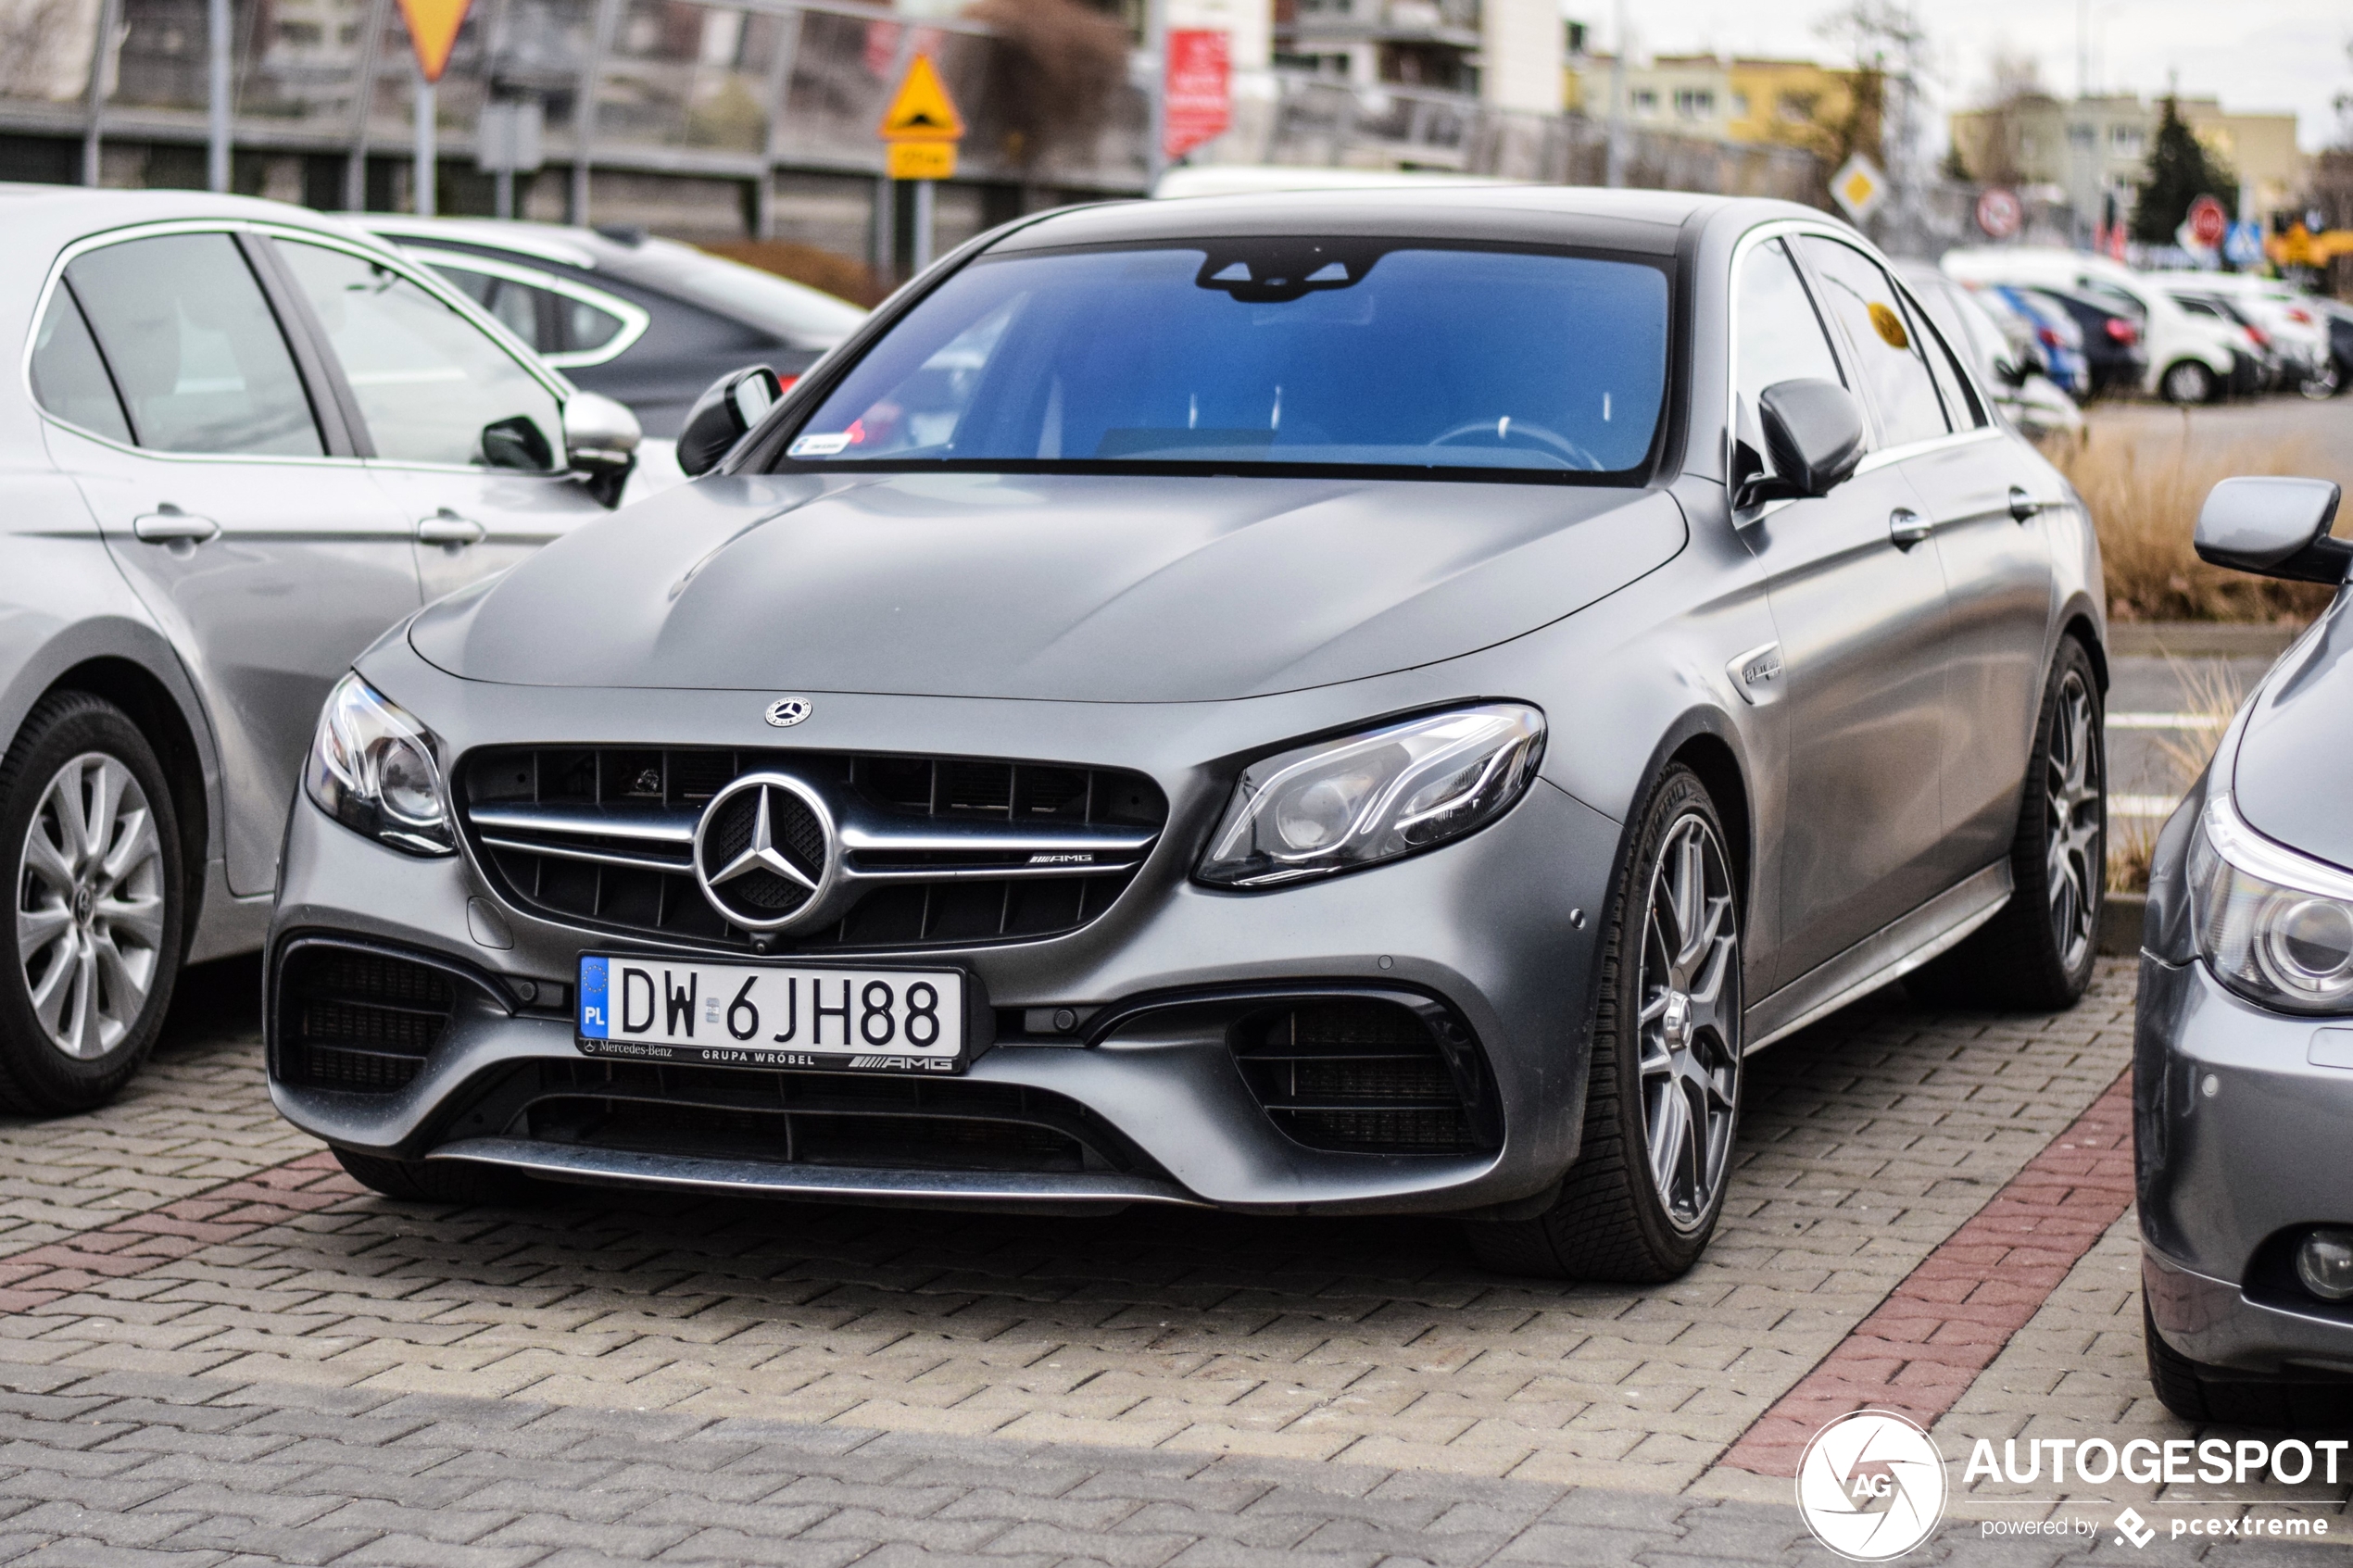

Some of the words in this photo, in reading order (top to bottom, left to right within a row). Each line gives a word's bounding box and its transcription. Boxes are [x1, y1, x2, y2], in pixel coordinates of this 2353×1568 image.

[622, 966, 698, 1038] DW
[726, 975, 940, 1047] 6JH88
[585, 1006, 605, 1026] PL
[599, 1041, 673, 1058] Mercedes-Benz
[702, 1049, 748, 1063] GRUPA
[754, 1050, 815, 1066] WRÓBEL
